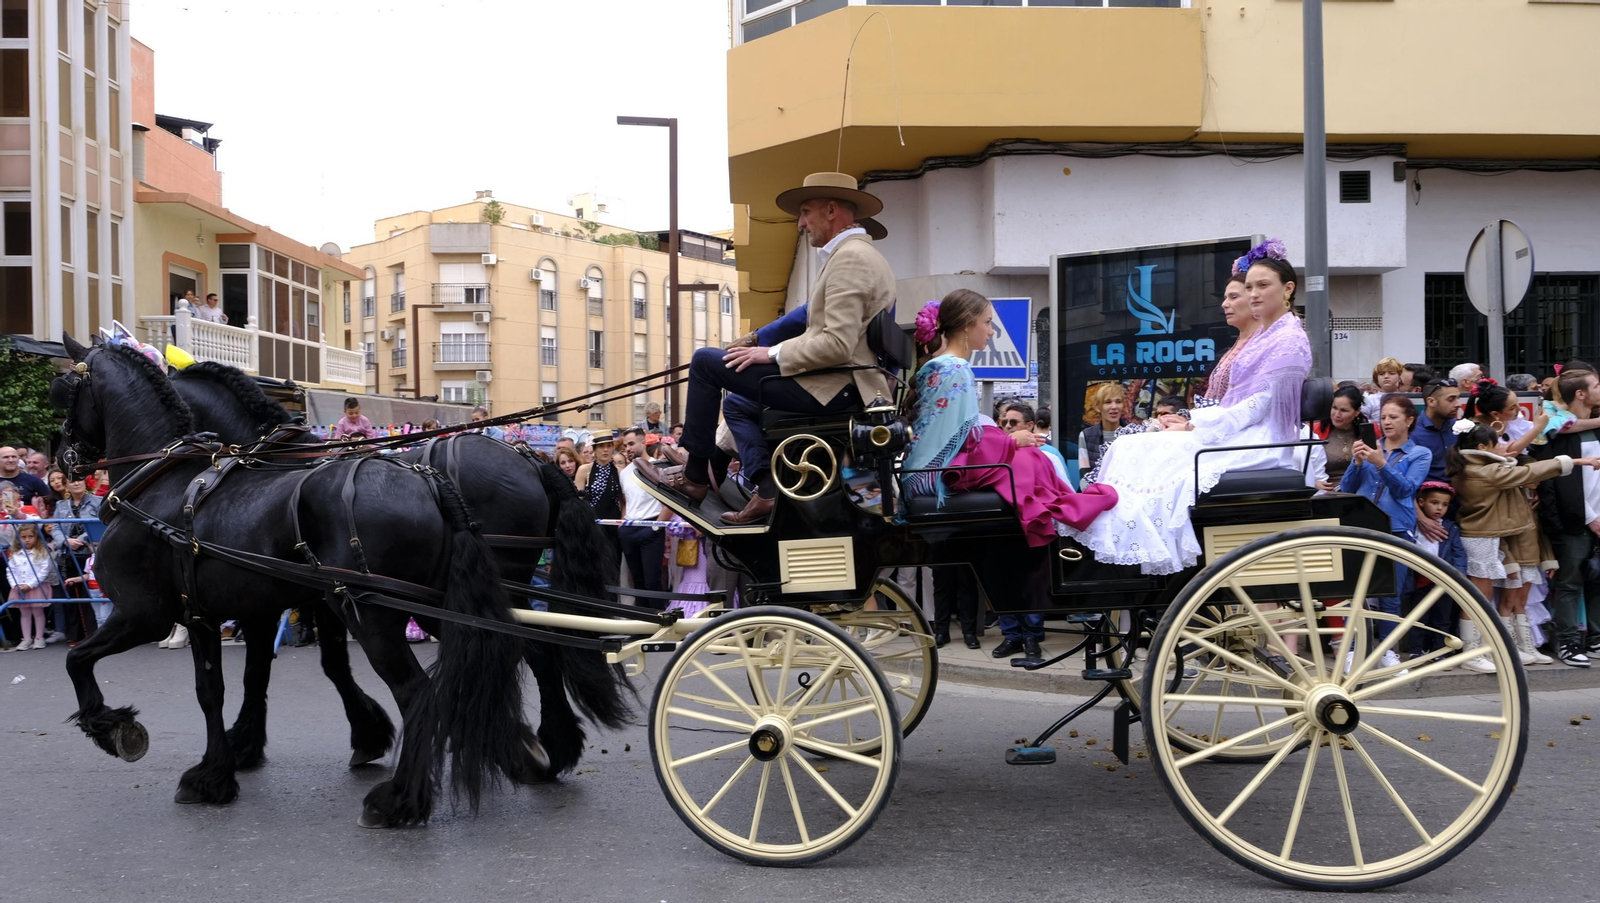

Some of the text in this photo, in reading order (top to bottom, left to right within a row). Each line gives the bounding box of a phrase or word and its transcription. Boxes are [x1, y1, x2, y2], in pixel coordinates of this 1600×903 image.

[1334, 332, 1348, 340] 334
[1090, 338, 1215, 365] LA ROCA
[1099, 364, 1206, 376] GASTRO BAR
